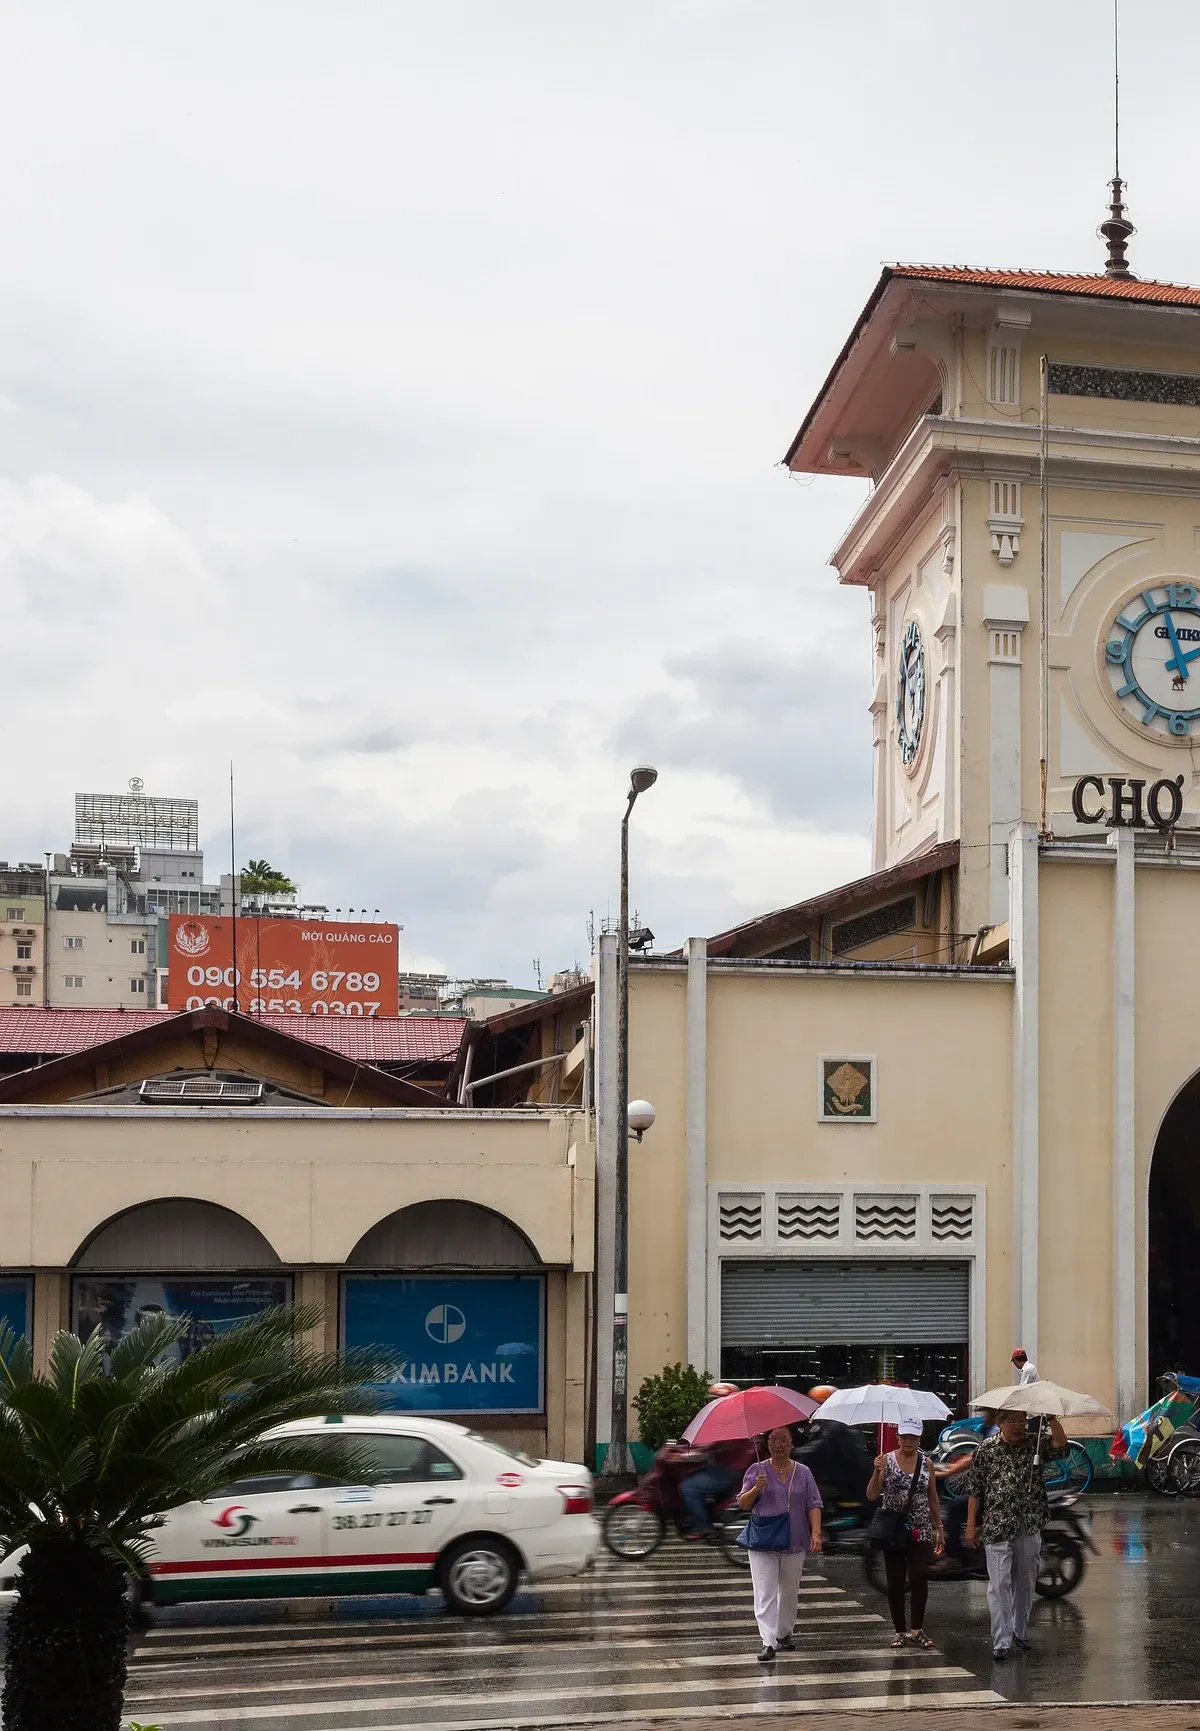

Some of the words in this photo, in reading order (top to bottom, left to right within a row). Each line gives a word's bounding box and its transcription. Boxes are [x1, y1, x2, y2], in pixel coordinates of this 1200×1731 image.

[1165, 583, 1198, 608] 12
[1106, 640, 1127, 664] 9
[1168, 714, 1190, 735] 6
[1071, 773, 1185, 834] CHỢ
[301, 930, 323, 941] MỜI
[326, 931, 366, 943] QUẢNG
[368, 933, 393, 944] CÁO
[187, 965, 241, 988] 090
[250, 968, 302, 990] 554
[311, 970, 381, 992] 6789
[249, 998, 302, 1015] 853
[310, 1000, 382, 1017] 0307
